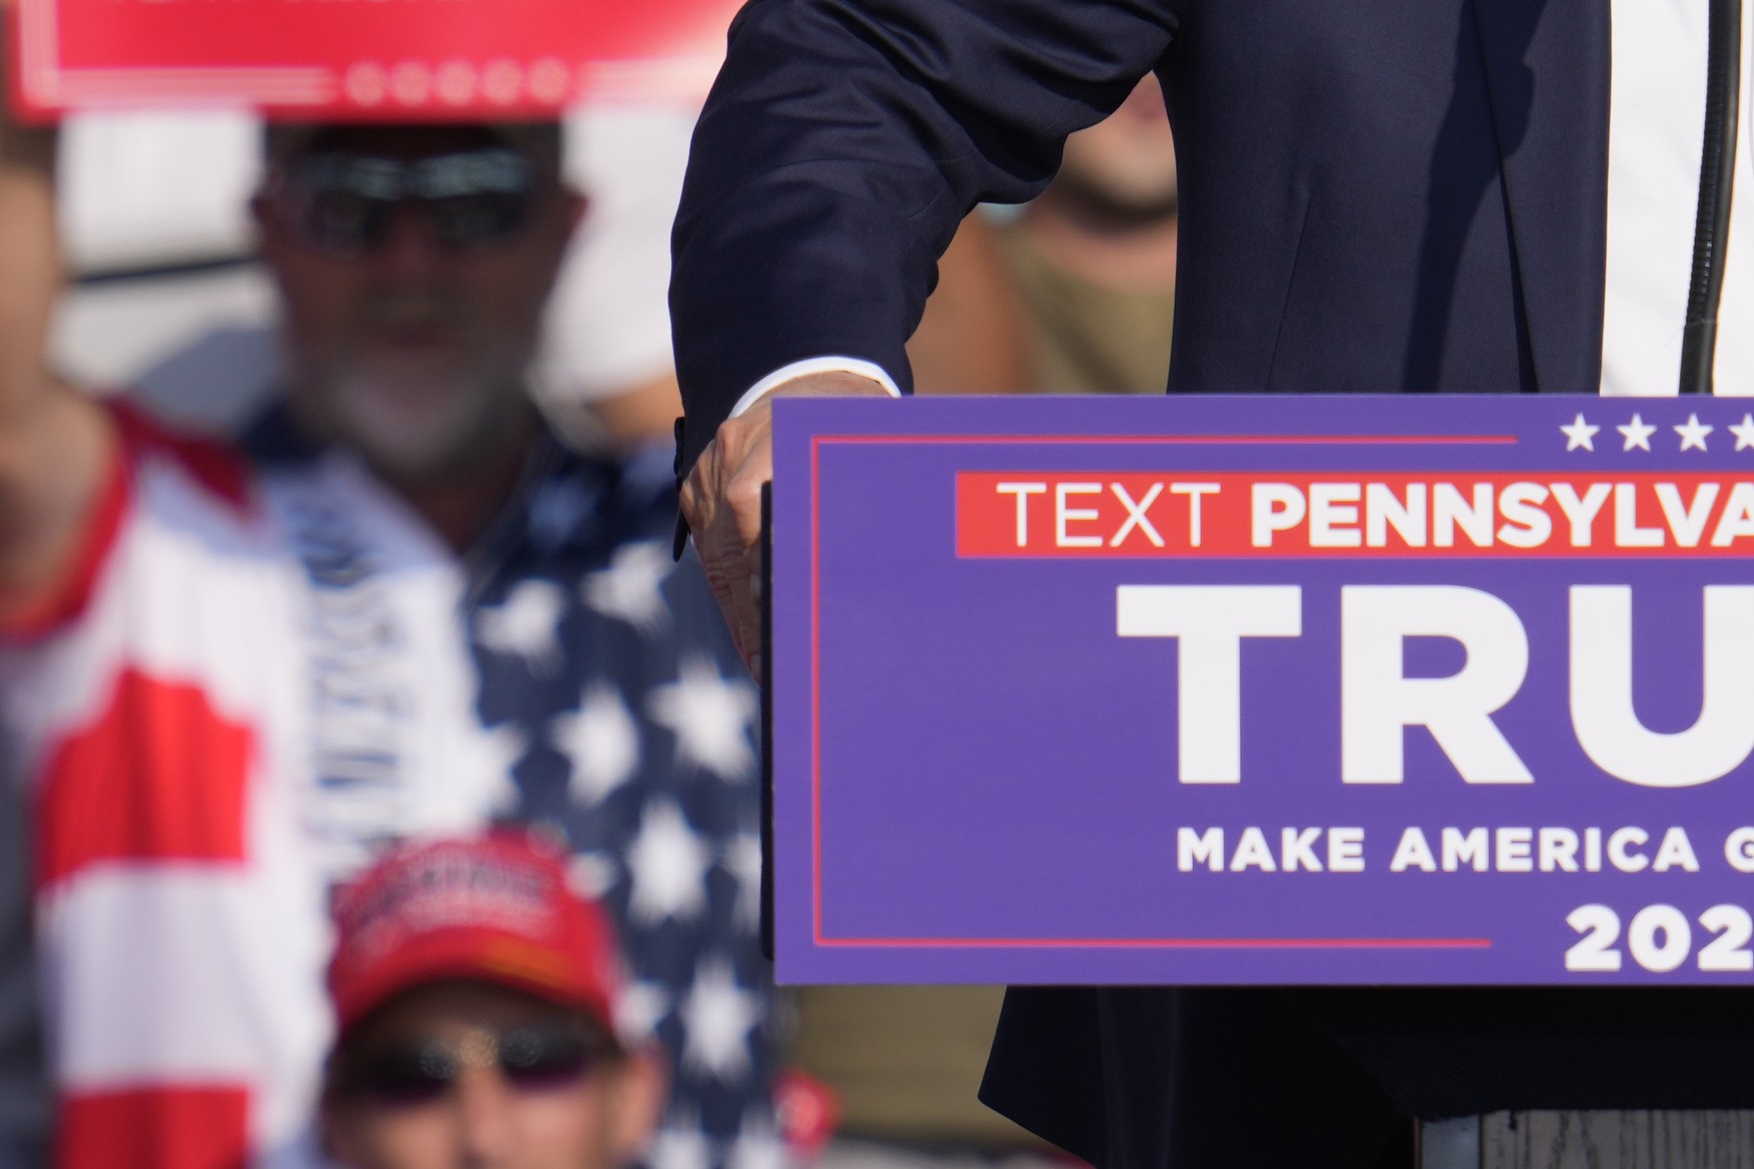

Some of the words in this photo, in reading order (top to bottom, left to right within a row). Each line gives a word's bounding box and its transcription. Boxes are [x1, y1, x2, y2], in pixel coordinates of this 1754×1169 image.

[997, 482, 1221, 548] TEXT
[1177, 826, 1366, 872] MAKE
[1390, 826, 1700, 873] AMERICA
